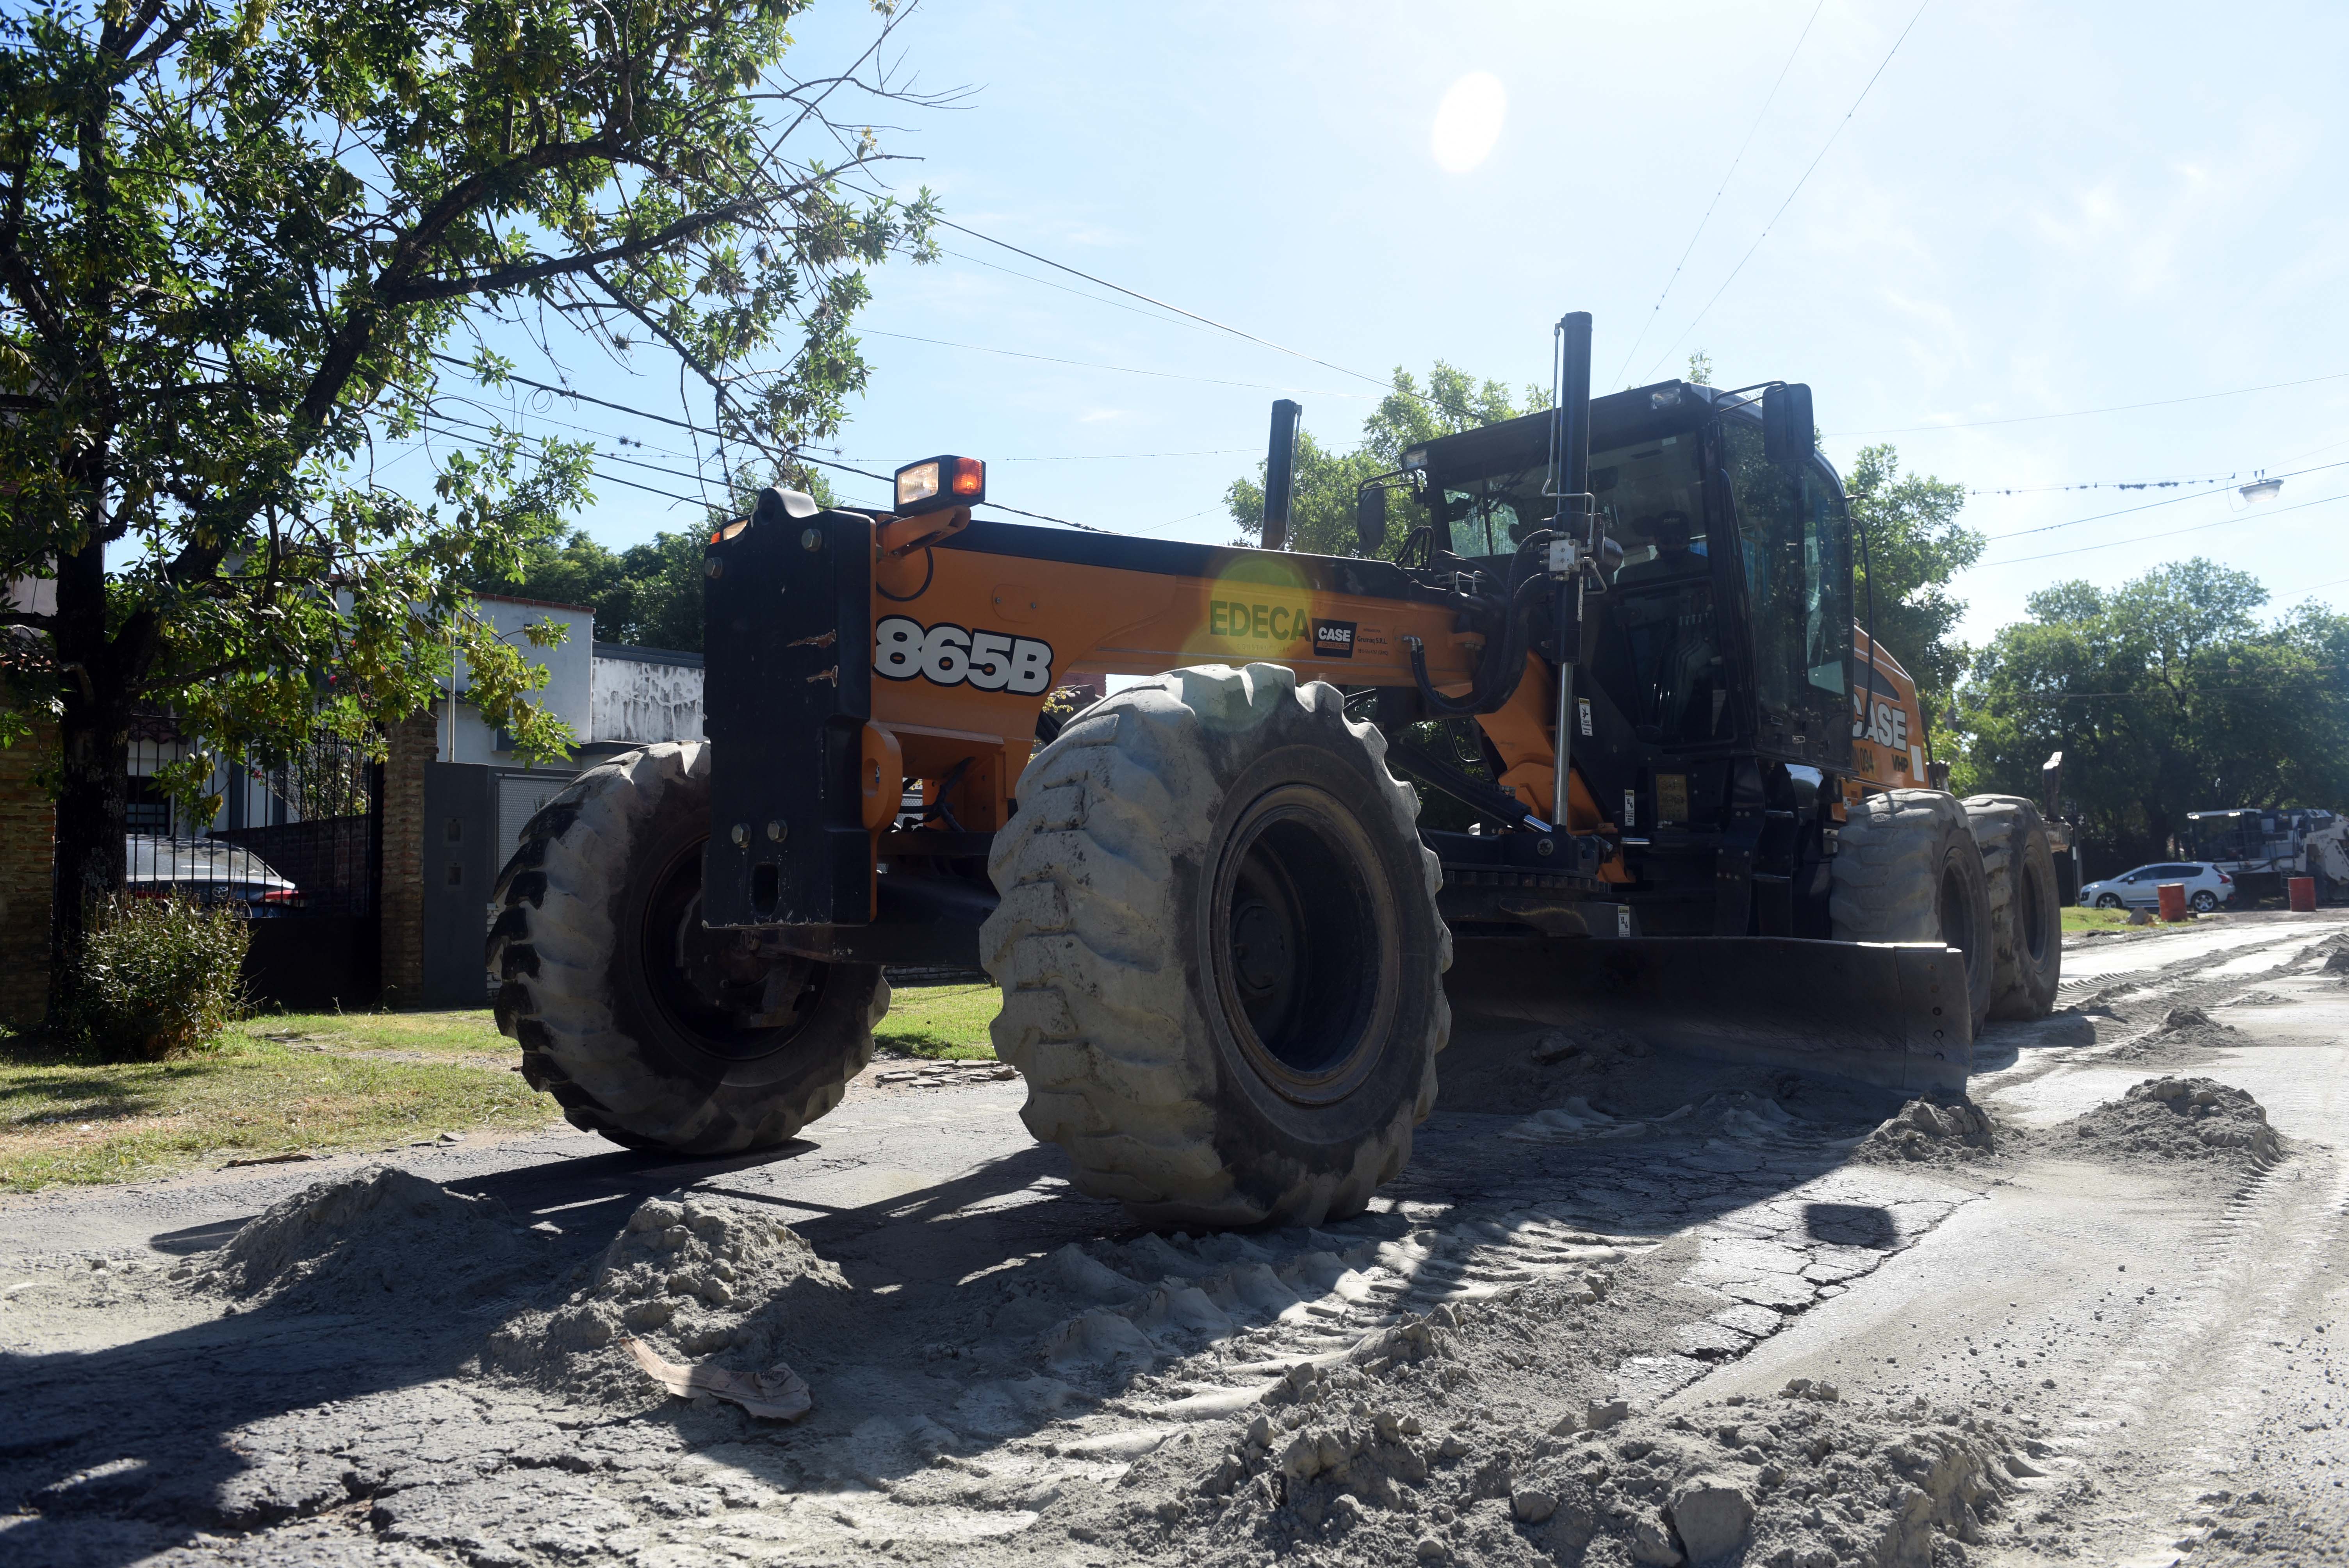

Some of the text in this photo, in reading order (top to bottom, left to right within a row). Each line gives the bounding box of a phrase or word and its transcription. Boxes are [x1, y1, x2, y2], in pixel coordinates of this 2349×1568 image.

[1210, 600, 1312, 642] EDECA
[1318, 627, 1351, 642] CASE
[1357, 636, 1375, 645] Grumaq
[873, 615, 1053, 696] 865B
[1237, 643, 1290, 652] CONSTRUCORA
[1892, 754, 1908, 773] VHP
